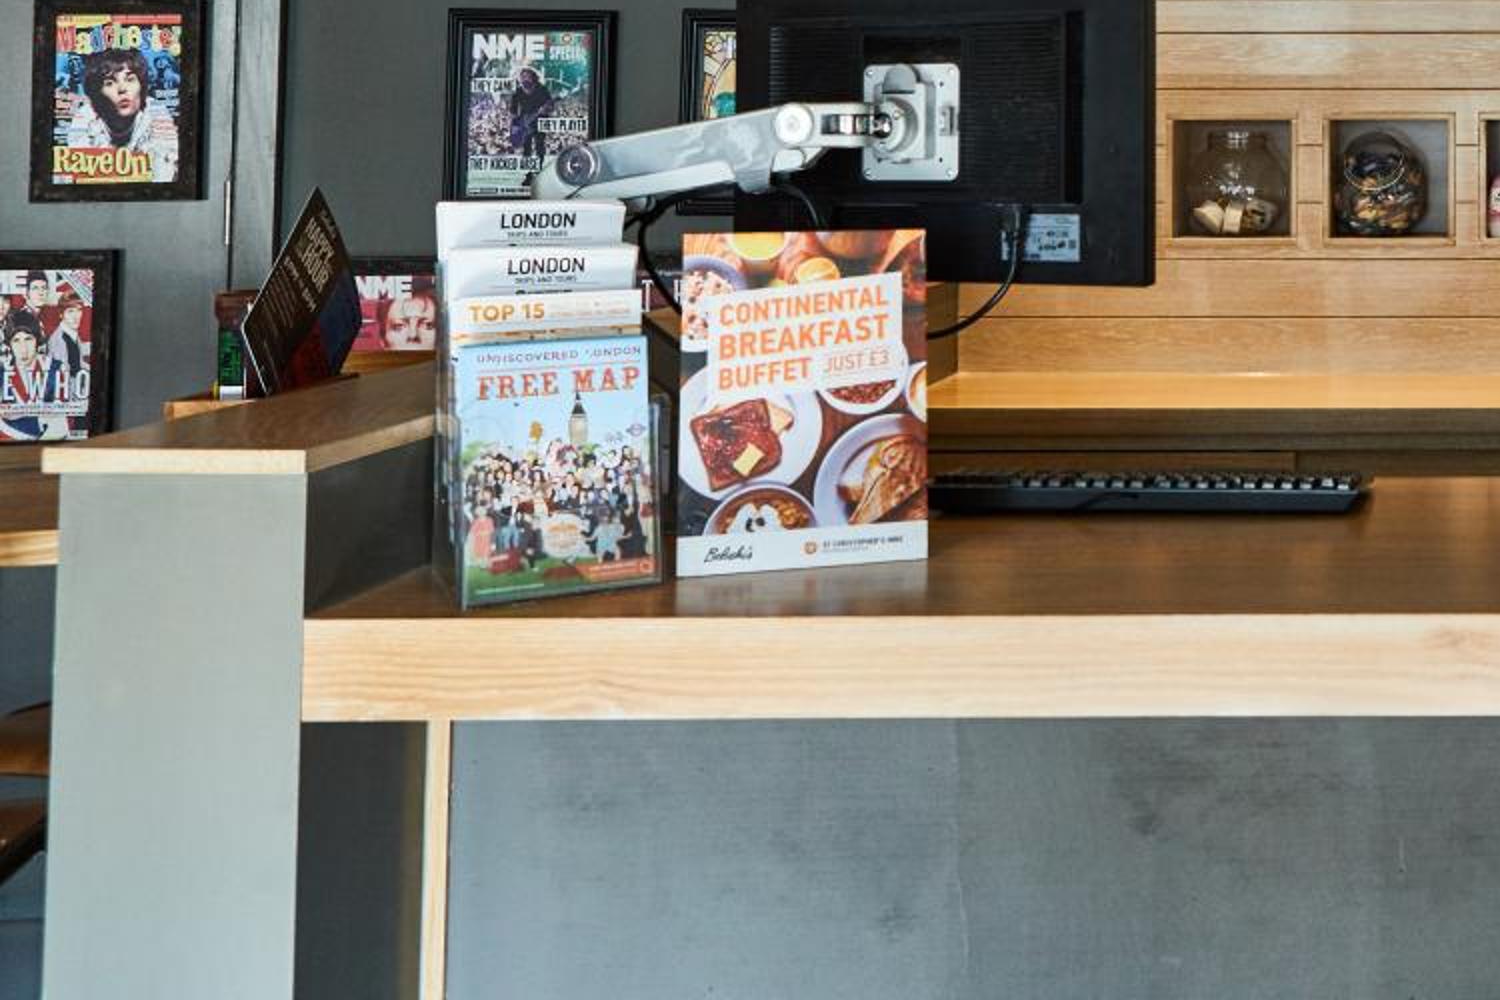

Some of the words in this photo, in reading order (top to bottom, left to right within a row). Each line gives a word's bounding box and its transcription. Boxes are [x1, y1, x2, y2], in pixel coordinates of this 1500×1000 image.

[472, 33, 544, 60] NME
[539, 118, 557, 132] THEY
[53, 146, 113, 177] Rave
[501, 213, 577, 229] LONDON
[508, 257, 585, 275] LONDON
[354, 276, 412, 300] NME
[469, 304, 515, 322] TOP
[521, 303, 545, 320] 15
[719, 284, 889, 328] CONTINENTAL
[718, 315, 890, 360] BREAKFAST
[29, 369, 91, 400] WHO
[478, 372, 560, 401] FREE
[572, 366, 641, 393] MAP
[718, 357, 812, 390] BUFFET
[824, 353, 864, 374] JUST
